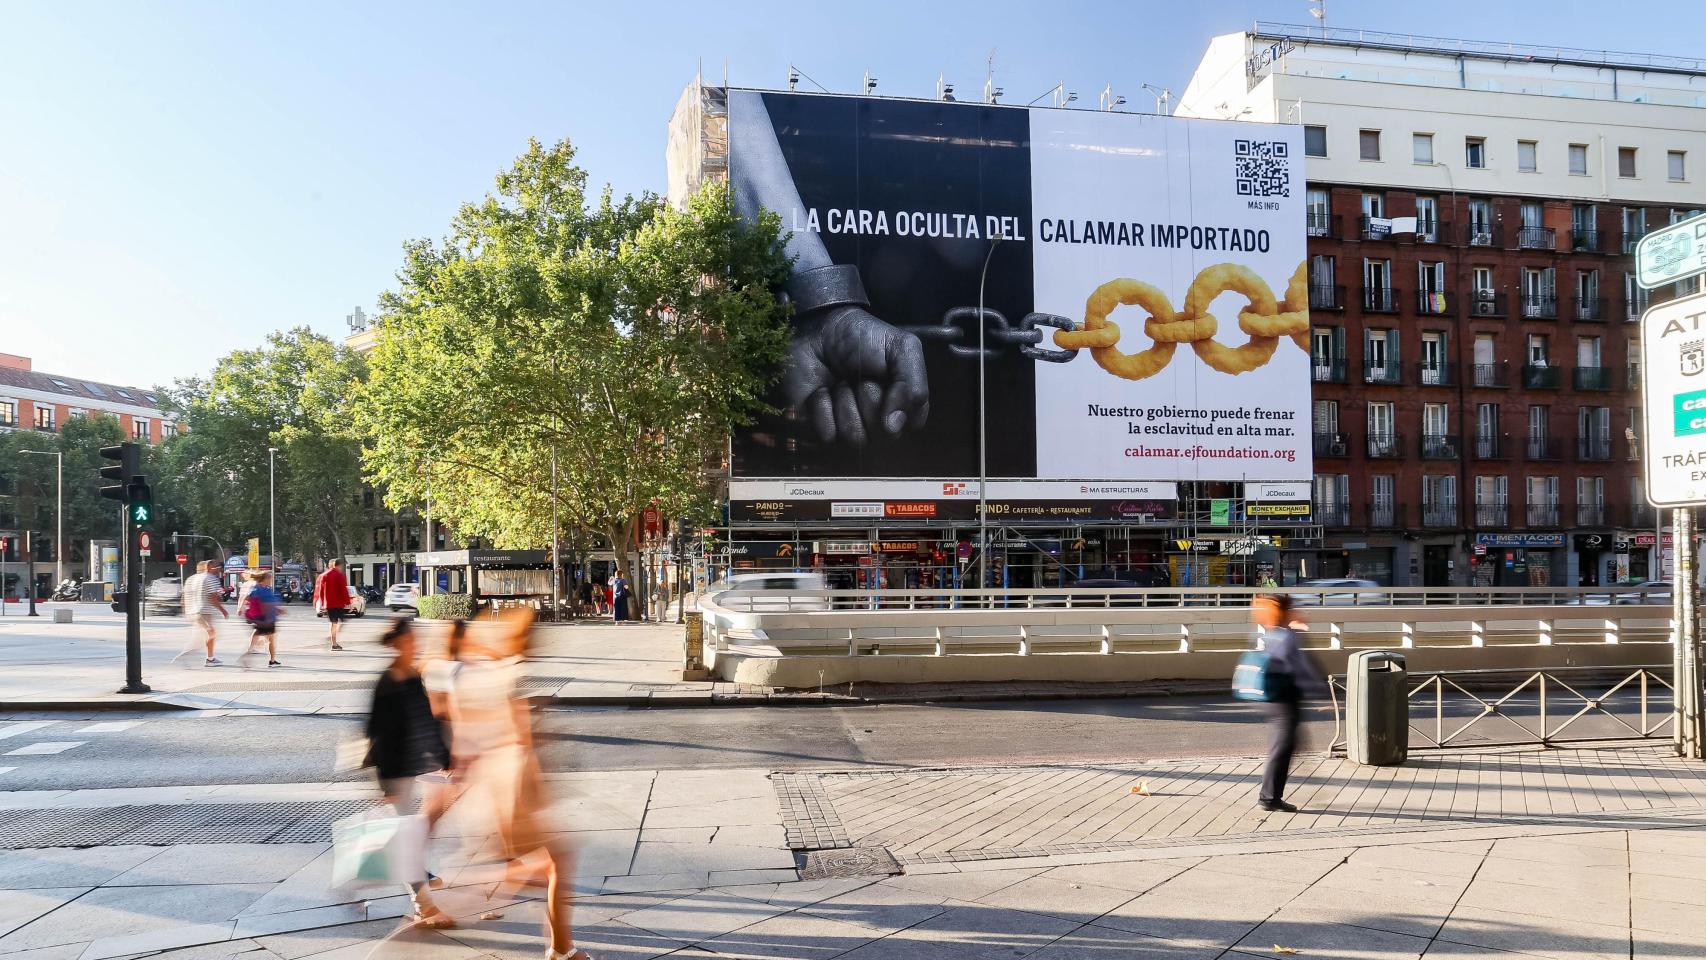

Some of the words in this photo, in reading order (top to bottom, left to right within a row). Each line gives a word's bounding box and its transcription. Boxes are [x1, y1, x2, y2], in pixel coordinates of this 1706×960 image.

[1246, 36, 1295, 77] HOSTAL
[1248, 200, 1262, 210] MÁS
[1264, 202, 1279, 211] INFO
[792, 207, 821, 233] LA
[827, 208, 890, 236] CARA
[895, 211, 980, 239] OCULTA
[986, 215, 1026, 241] DEL
[1039, 217, 1145, 247] CALAMAR
[1150, 223, 1271, 253] IMPORTADO
[1088, 404, 1144, 418] Nuestro
[1147, 406, 1208, 420] gobierno
[1210, 407, 1251, 422] puede
[1254, 408, 1295, 420] frenar
[1128, 422, 1141, 434] la
[1144, 423, 1214, 435] esclavitud
[1217, 426, 1233, 436] en
[1236, 424, 1261, 436] alta
[1265, 426, 1295, 437] mar.
[1124, 445, 1296, 462] calamar.ejfoundation.org
[790, 488, 825, 496] JCDecaux
[896, 504, 935, 513] TABACOS
[1013, 506, 1044, 514] CAFETERÍA
[1225, 541, 1256, 549] EXCHAN
[473, 554, 511, 562] restaurante
